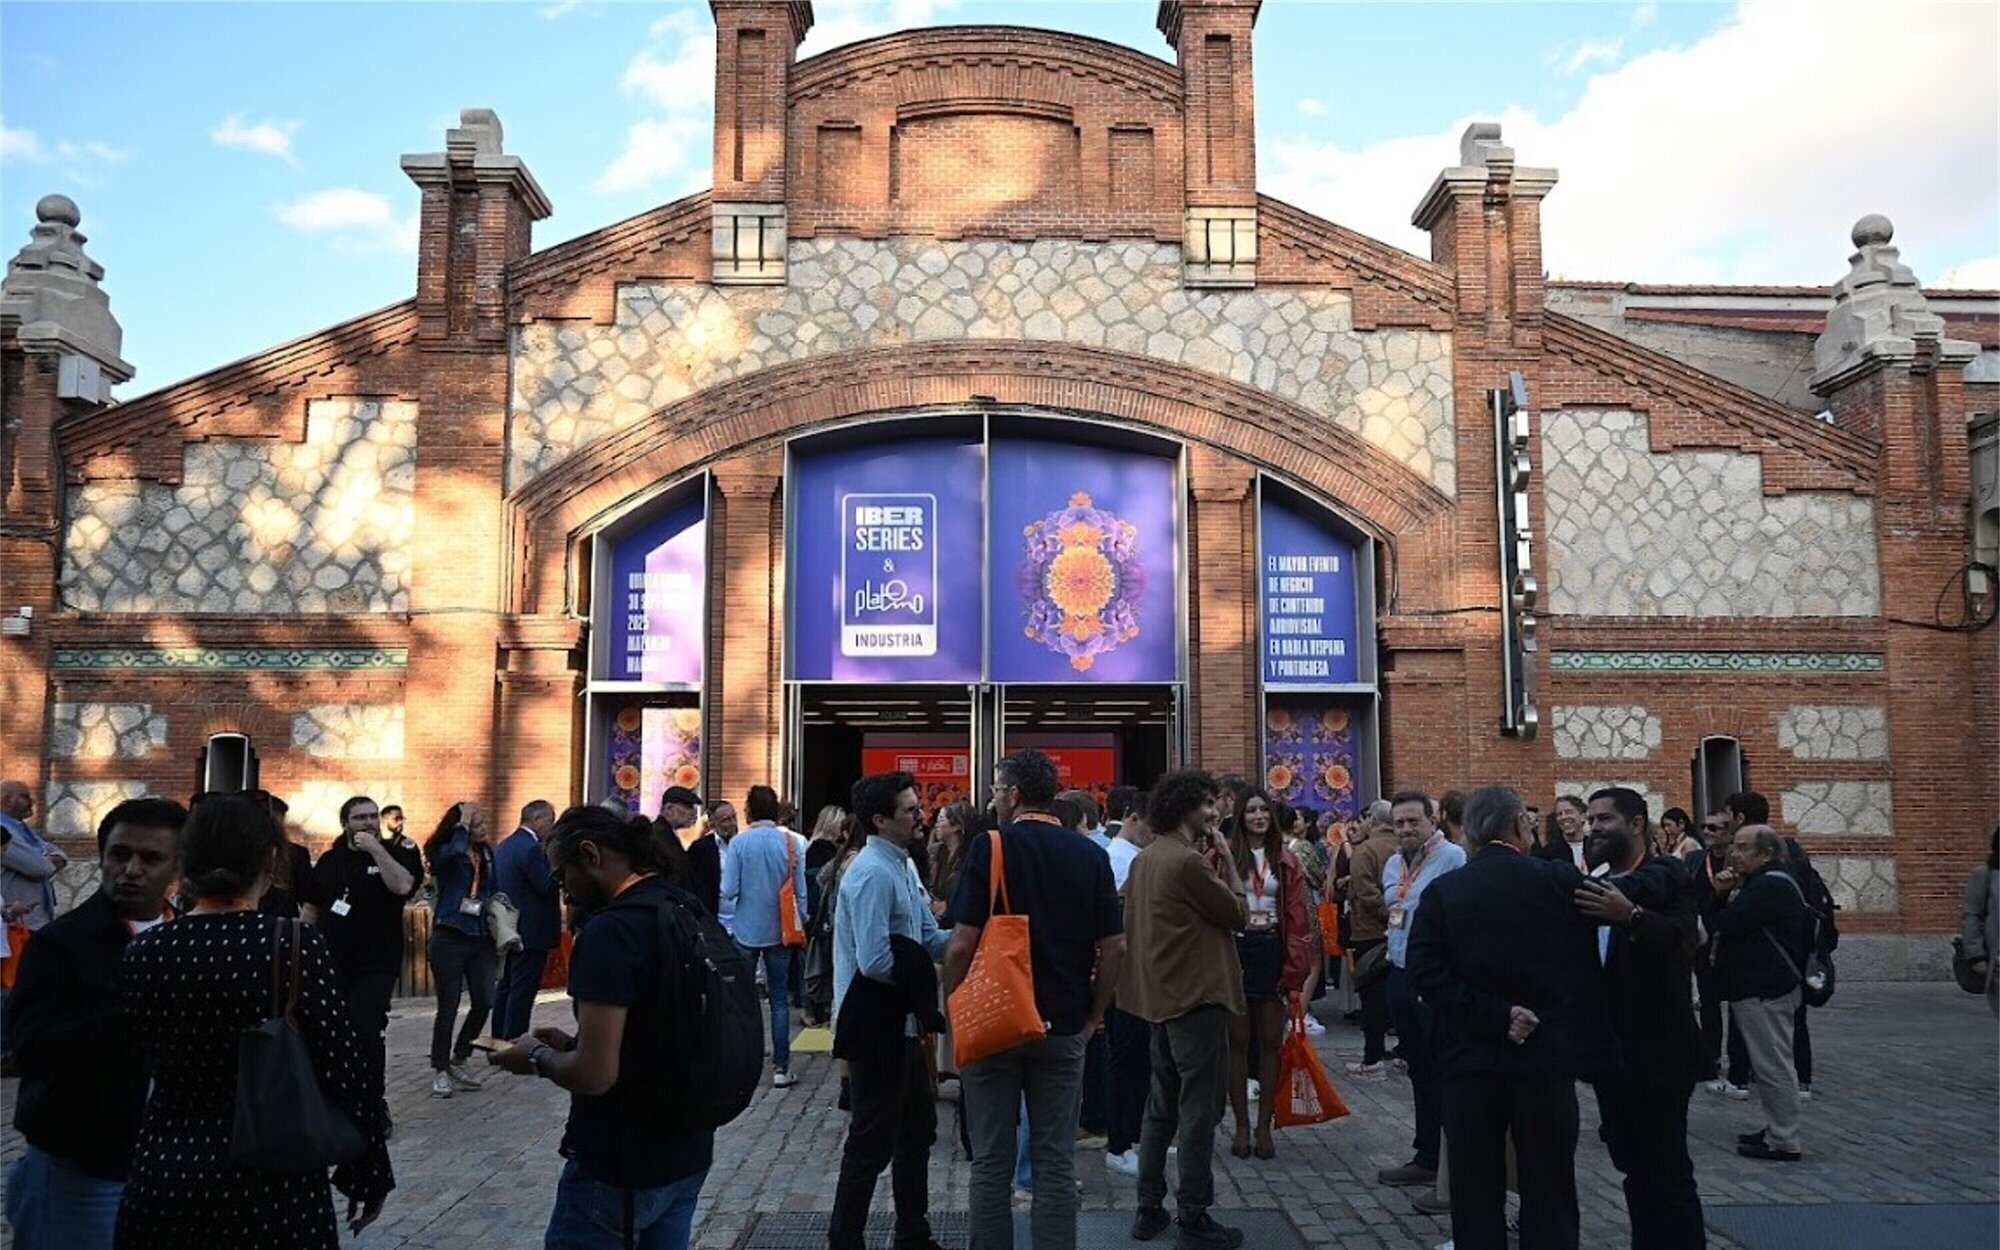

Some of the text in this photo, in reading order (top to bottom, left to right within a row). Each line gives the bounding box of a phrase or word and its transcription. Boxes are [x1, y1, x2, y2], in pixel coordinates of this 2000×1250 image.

[855, 506, 923, 526] IBER
[855, 527, 923, 551] SERIES
[883, 557, 894, 573] &
[1268, 555, 1339, 573] EL MAYOR EVENTO
[1268, 576, 1314, 593] DE NEGOCIO
[1268, 597, 1325, 614] DE CONTENIDO
[855, 633, 923, 648] INDUSTRIA
[1270, 639, 1280, 656] EN
[1270, 659, 1330, 677] Y PORTUGUESA
